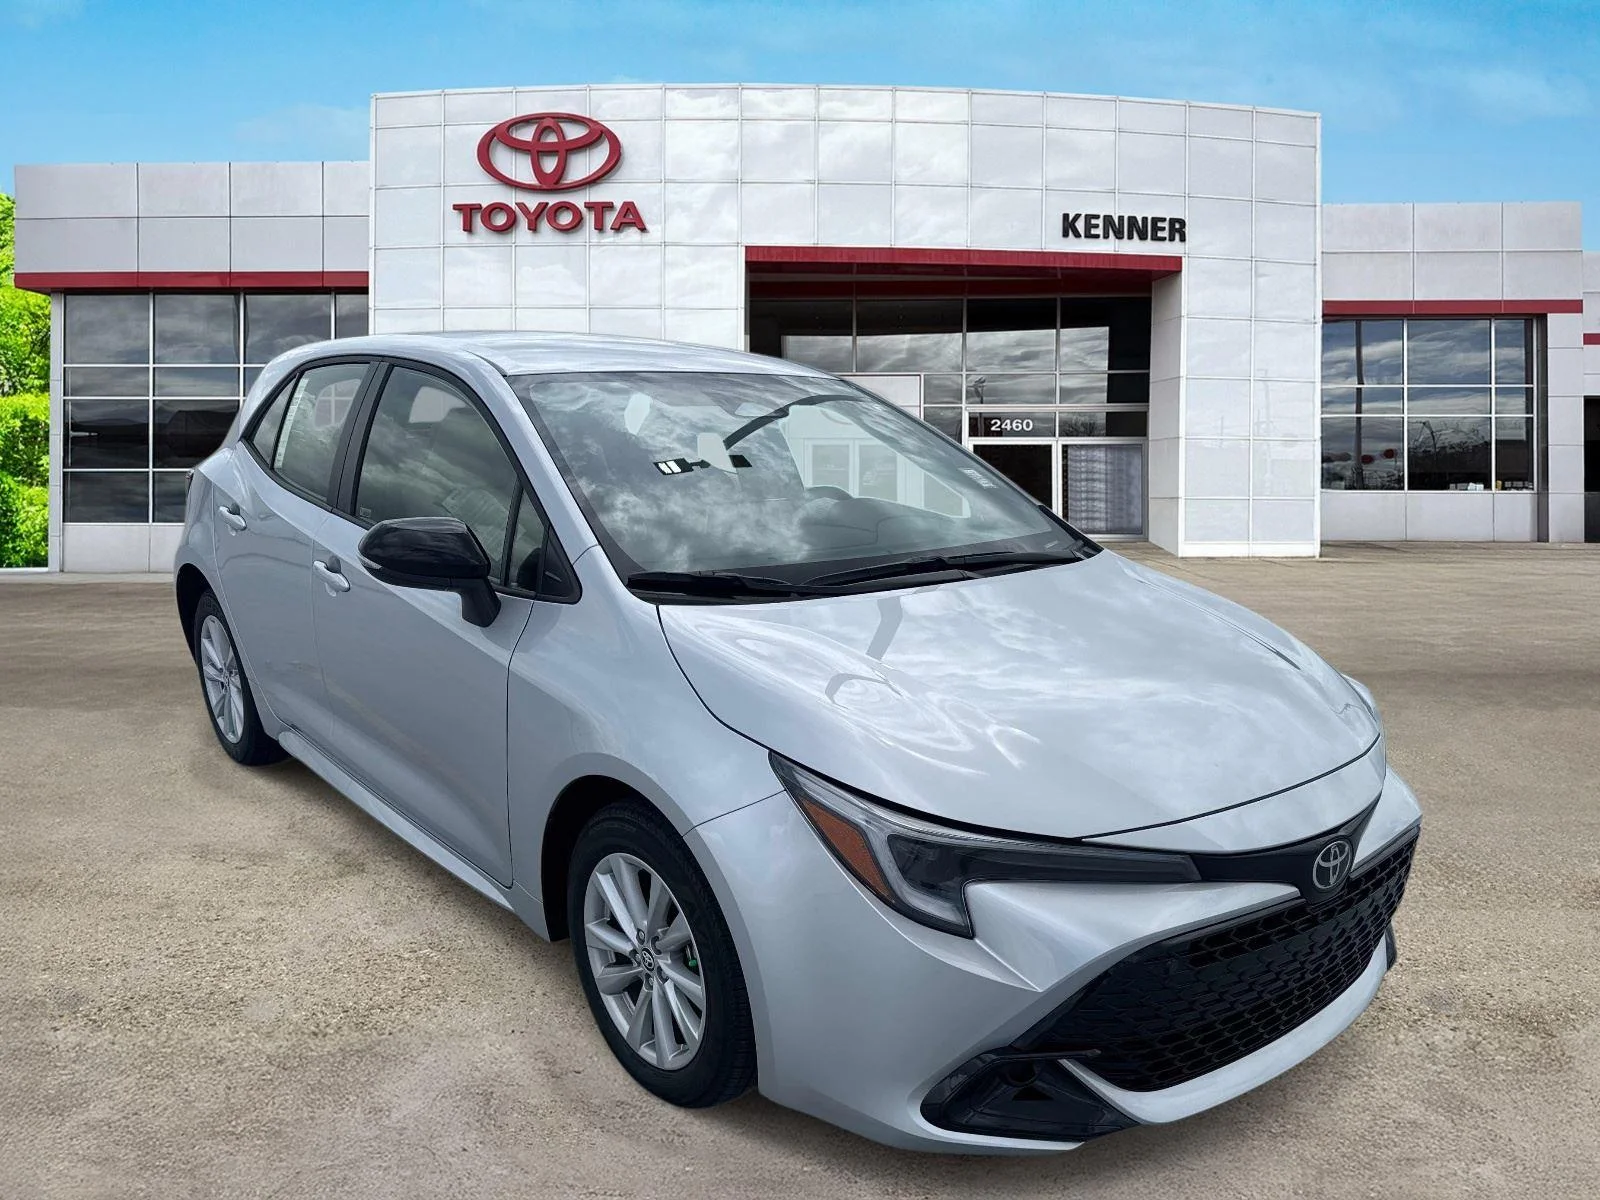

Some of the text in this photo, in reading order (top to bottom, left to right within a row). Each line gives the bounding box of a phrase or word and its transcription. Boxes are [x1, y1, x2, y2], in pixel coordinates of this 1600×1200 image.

[452, 201, 648, 232] TOYOTA
[1062, 213, 1187, 242] KENNER
[990, 419, 1033, 431] 2460
